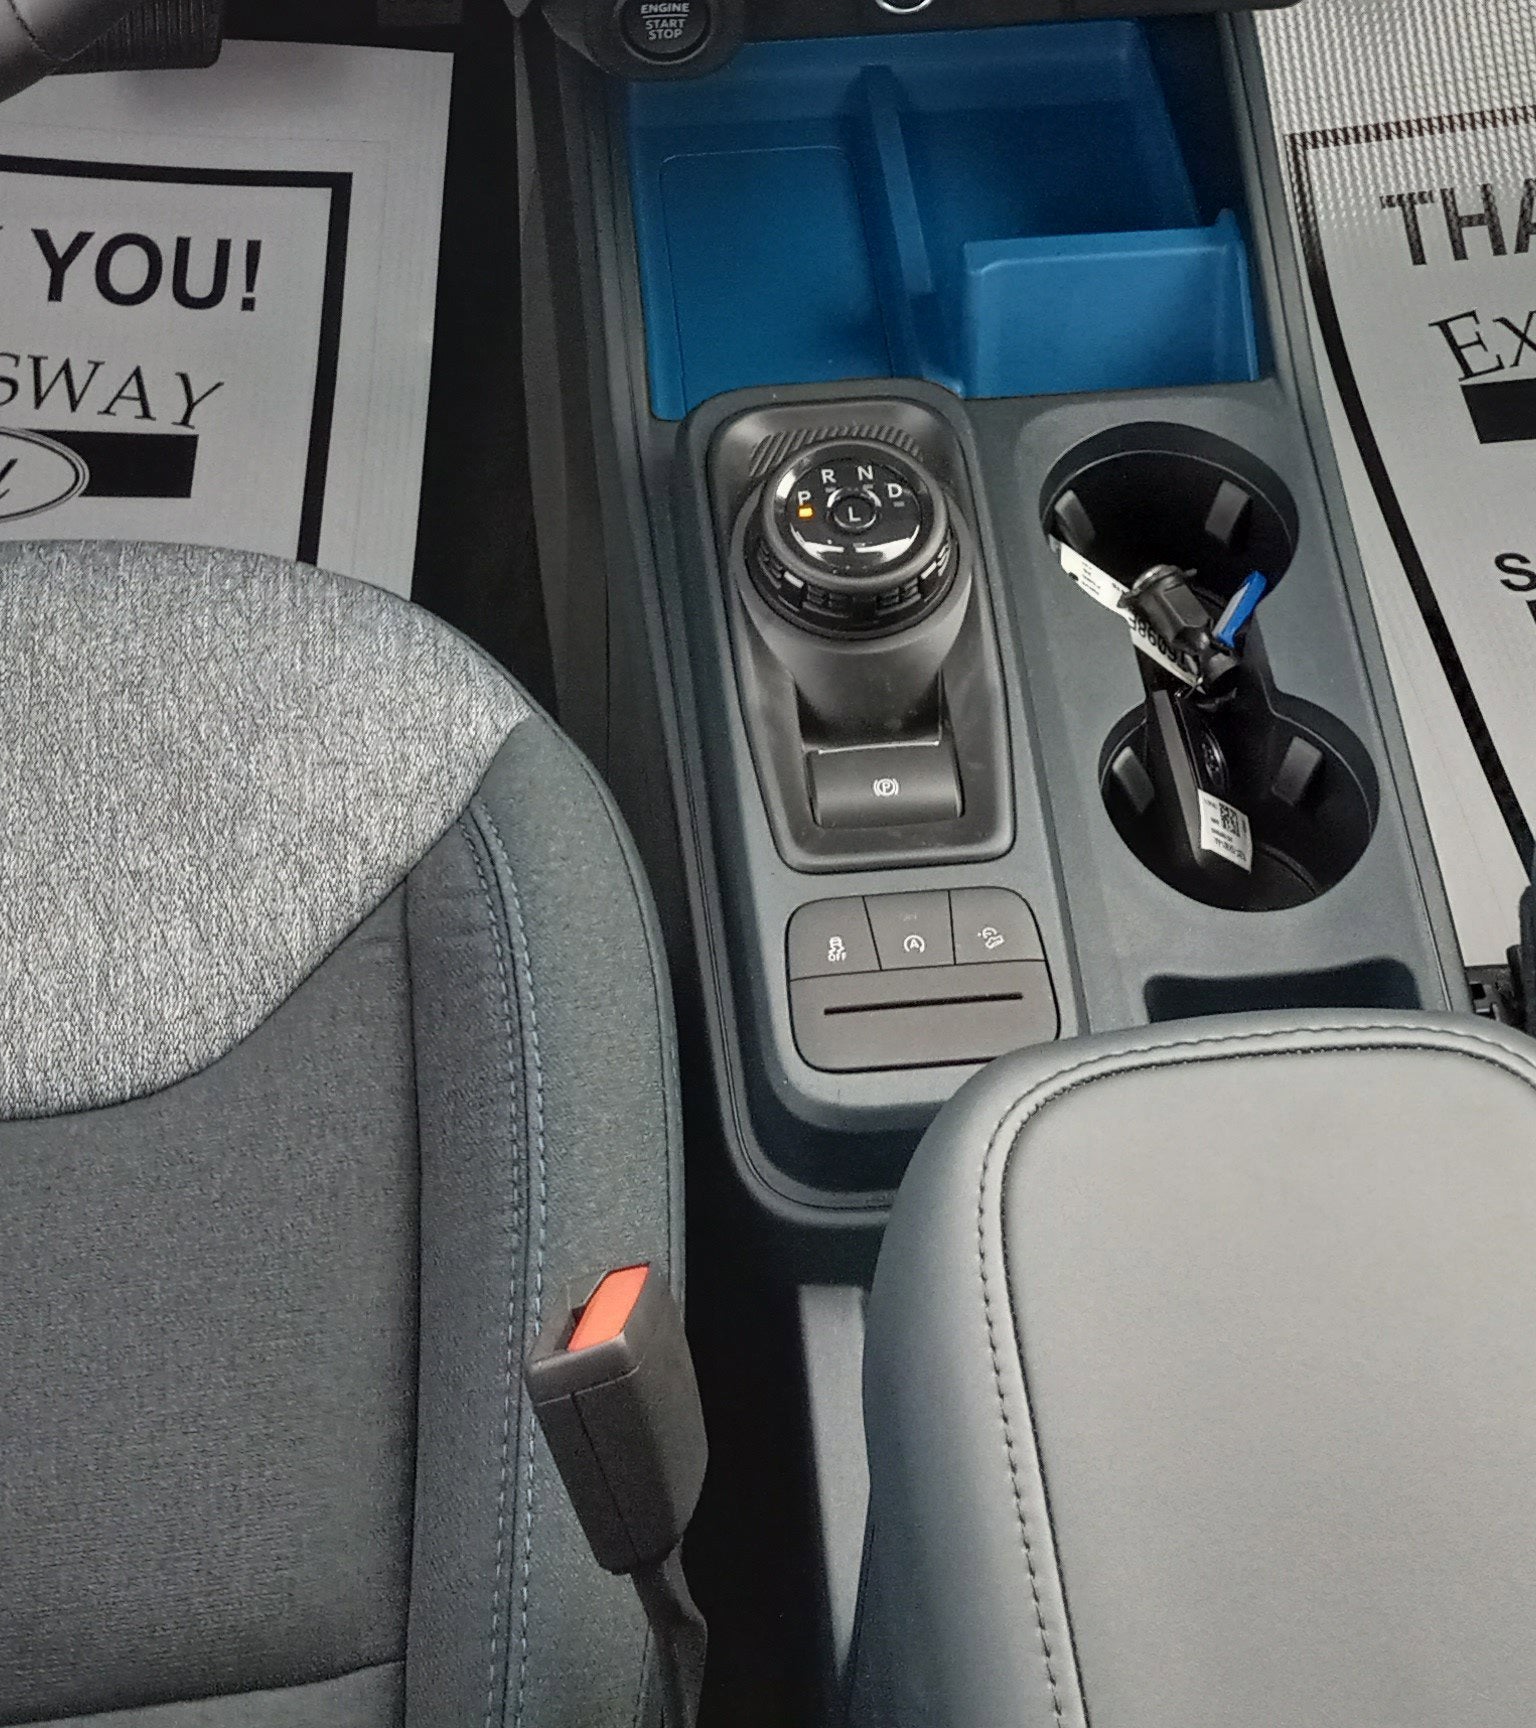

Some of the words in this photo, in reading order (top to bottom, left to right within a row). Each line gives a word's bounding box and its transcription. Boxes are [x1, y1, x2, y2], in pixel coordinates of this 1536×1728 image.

[641, 3, 690, 14] ENGINE
[646, 19, 685, 30] START
[649, 29, 683, 40] STOP
[31, 227, 262, 312] YOU!
[798, 490, 811, 506] P
[821, 469, 837, 484] R
[857, 465, 873, 480] N
[887, 483, 902, 498] D
[848, 506, 861, 522] L
[828, 951, 847, 962] OFF
